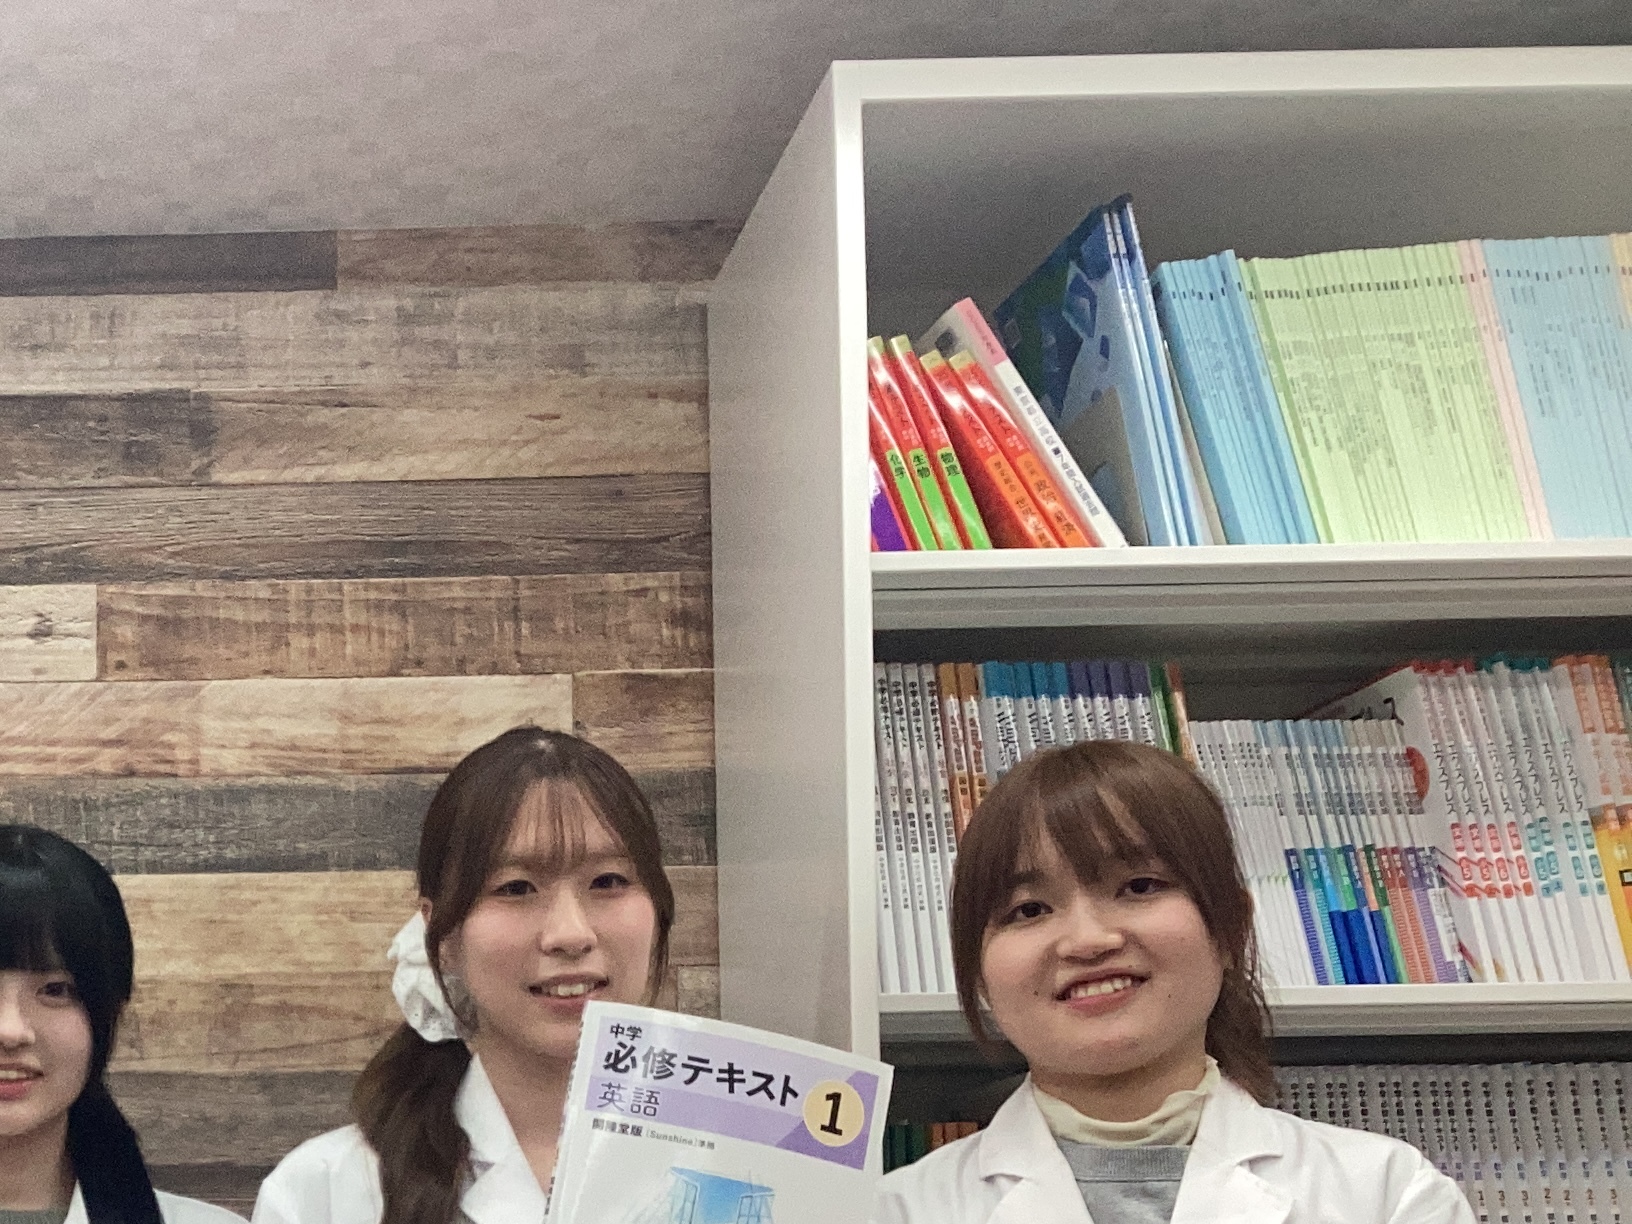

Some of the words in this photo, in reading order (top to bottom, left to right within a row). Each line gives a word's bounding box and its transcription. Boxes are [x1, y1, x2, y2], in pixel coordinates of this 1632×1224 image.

[610, 1023, 643, 1042] 中学
[596, 1081, 661, 1118] 英語
[603, 1042, 800, 1107] 必修テキスト
[820, 1091, 843, 1136] 1
